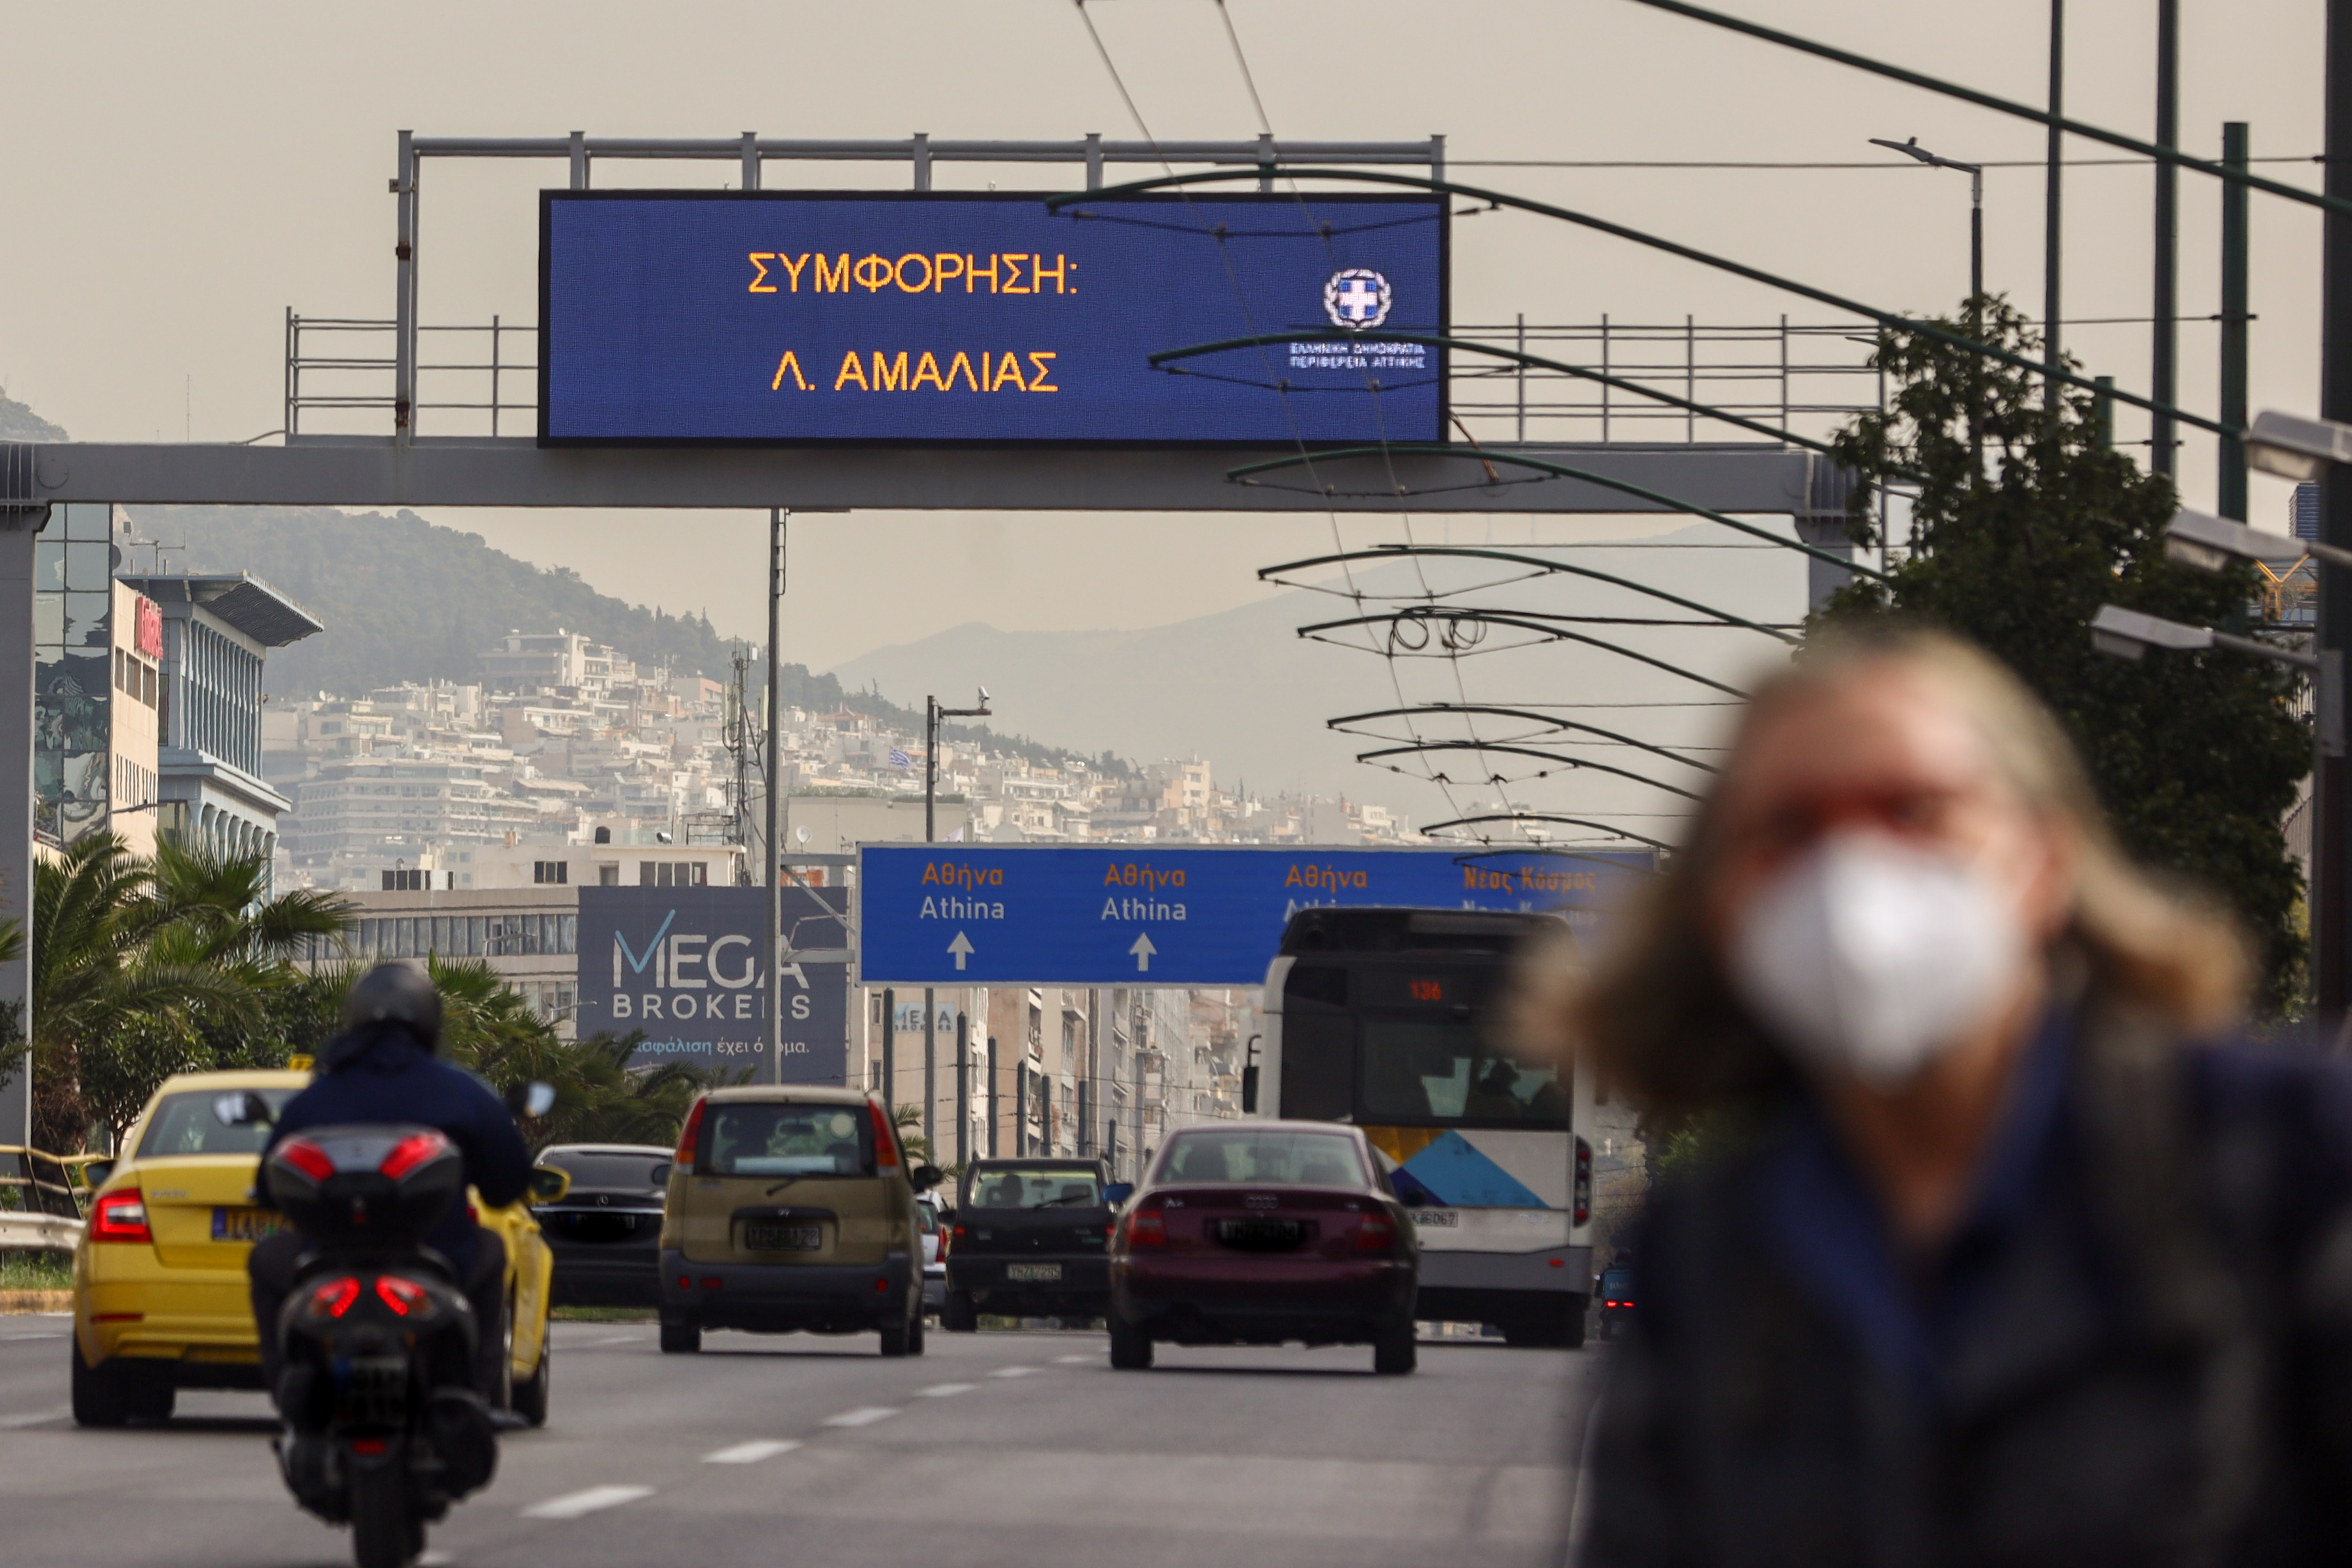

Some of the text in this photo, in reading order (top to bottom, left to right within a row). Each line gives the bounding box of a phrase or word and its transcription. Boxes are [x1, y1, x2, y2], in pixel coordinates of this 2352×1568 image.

[748, 252, 1077, 295] ΣΥΜΦΟΡΗΣΗ:
[771, 350, 1059, 392] Λ. ΑΜΑΛΙΑΣ
[921, 862, 1003, 891] Αθήνα
[1104, 863, 1185, 892] Αθήνα
[1285, 864, 1367, 893] Αθήνα
[920, 896, 1004, 919] Athina
[1102, 897, 1185, 920] Athina
[1411, 981, 1442, 1001] 136
[613, 993, 810, 1020] BROKES
[717, 1037, 749, 1056] έχει
